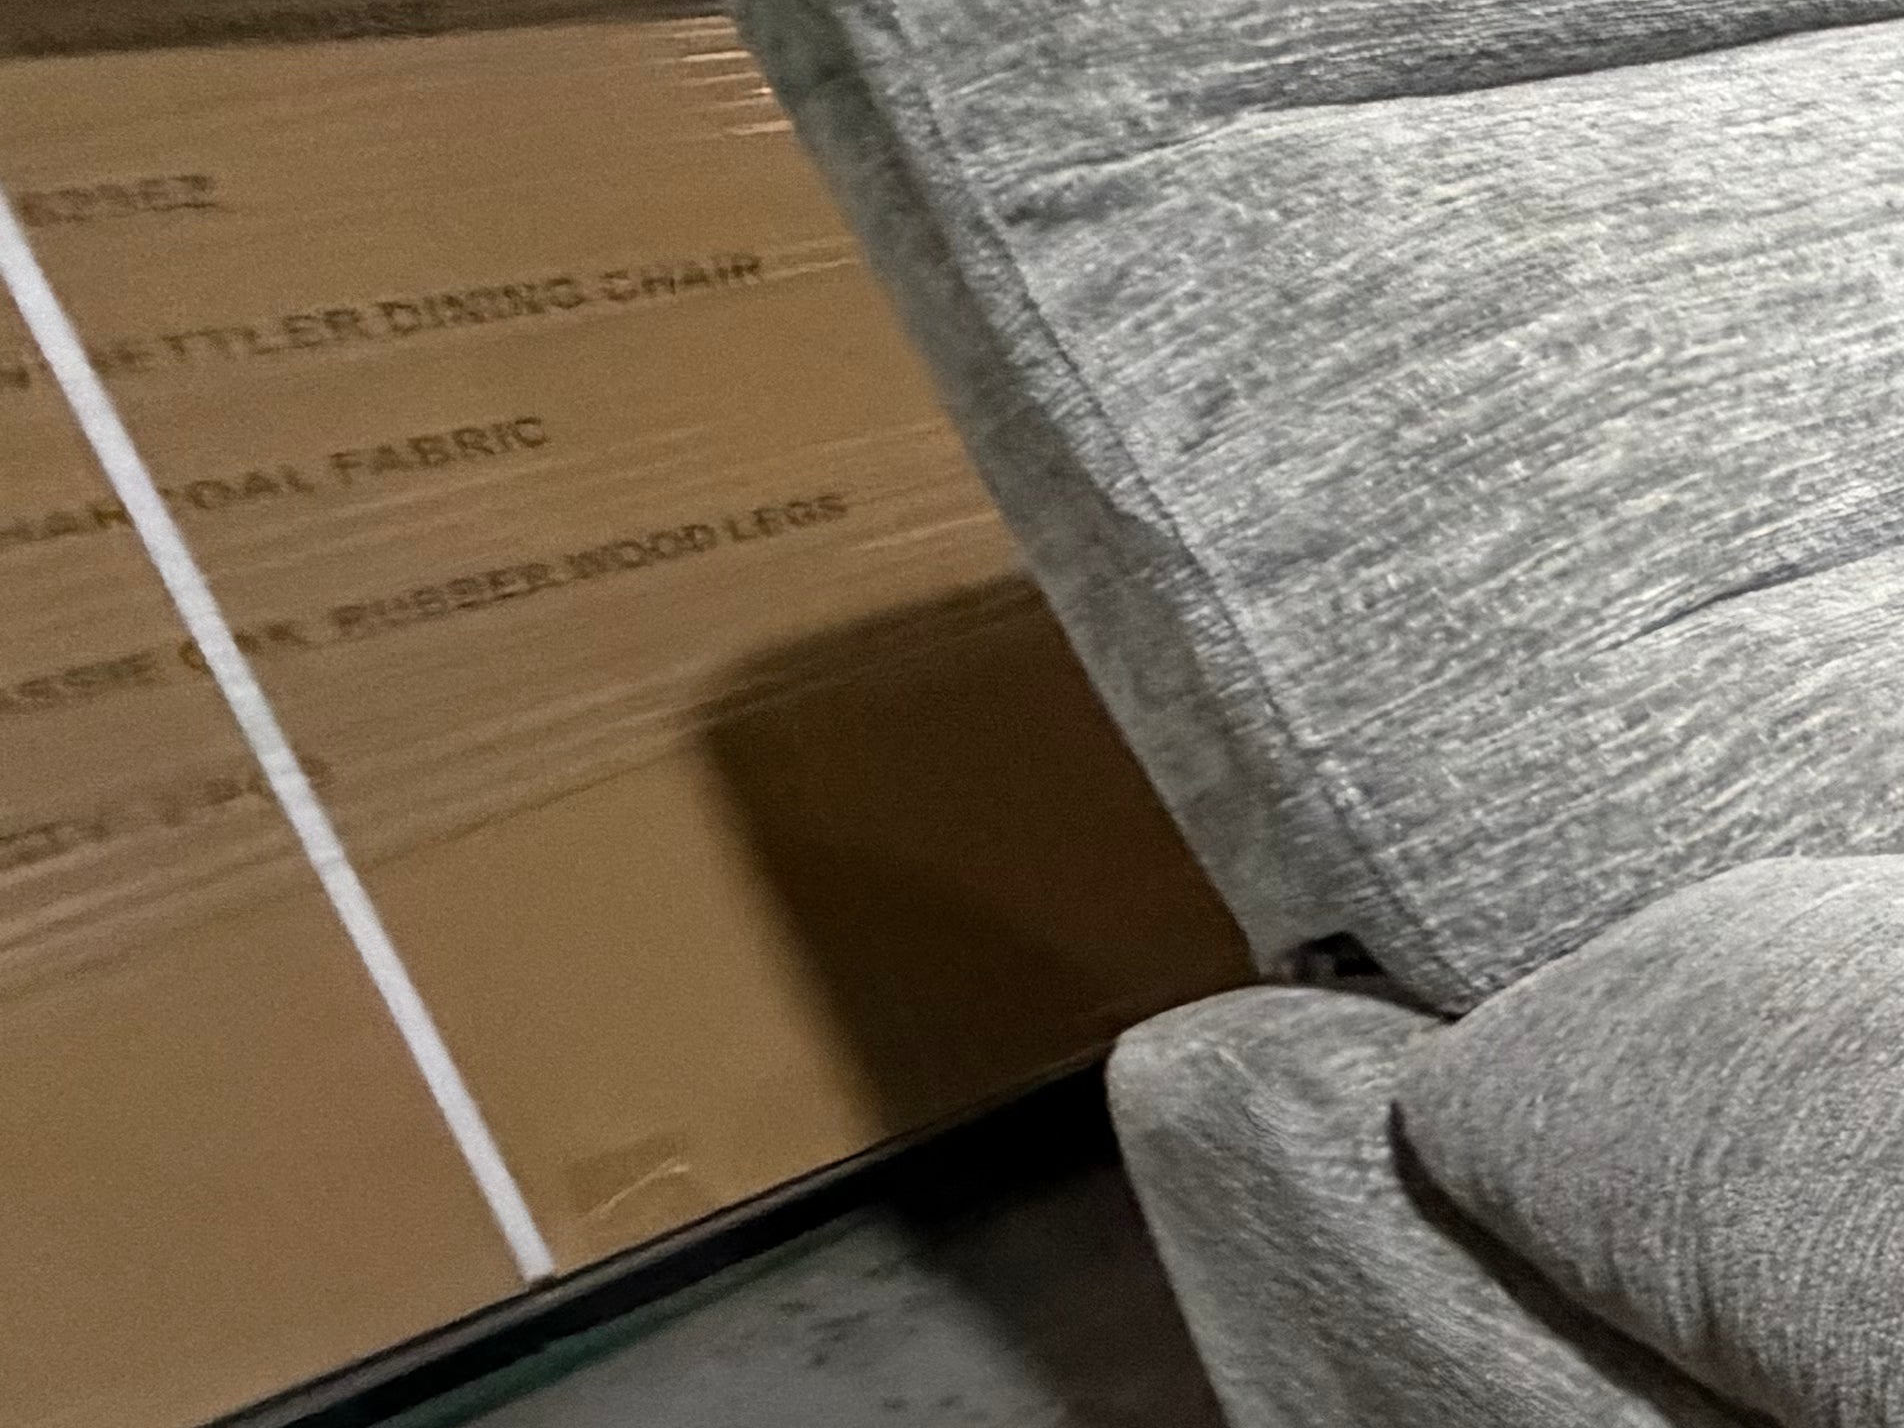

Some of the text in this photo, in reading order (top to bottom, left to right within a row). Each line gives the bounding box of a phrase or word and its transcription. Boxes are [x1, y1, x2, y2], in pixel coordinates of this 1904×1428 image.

[377, 276, 586, 336] DINING
[602, 252, 762, 302] CHAIR
[330, 416, 549, 483] FABRIC
[566, 523, 717, 580] WOOD
[723, 492, 850, 543] LEGS
